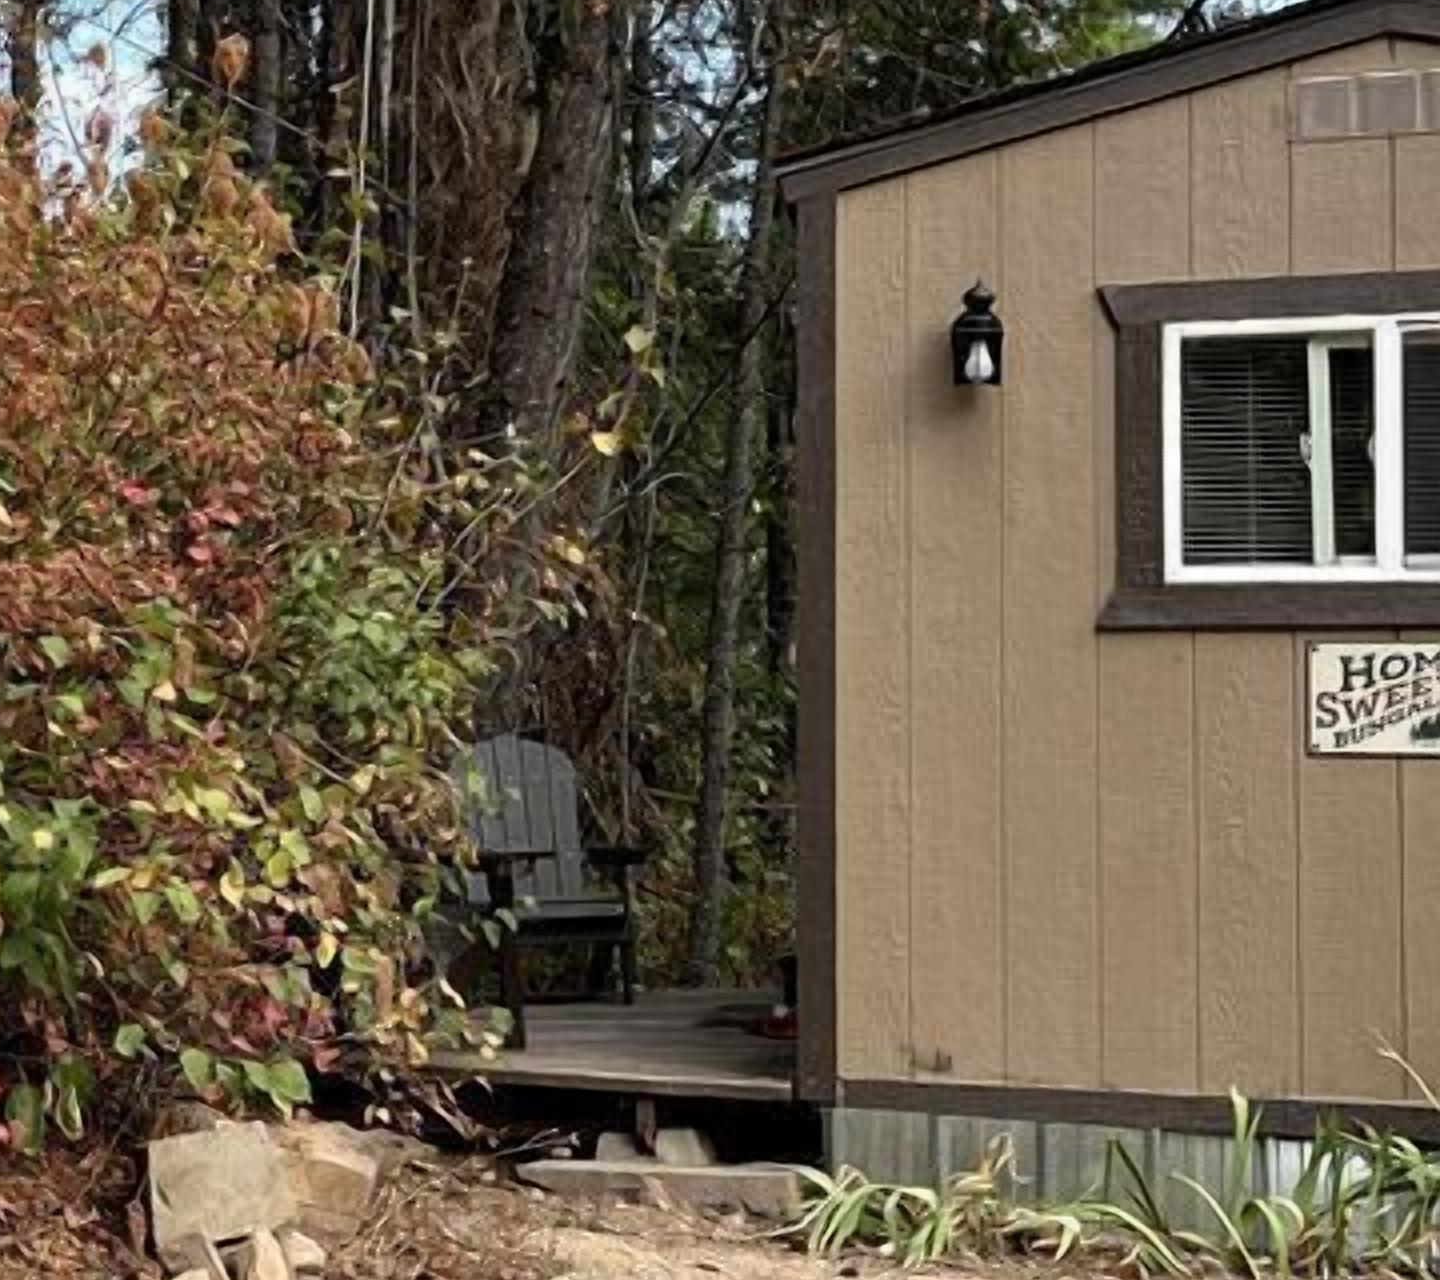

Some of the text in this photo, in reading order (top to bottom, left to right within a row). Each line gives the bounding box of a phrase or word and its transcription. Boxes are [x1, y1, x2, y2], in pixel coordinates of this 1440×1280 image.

[1339, 651, 1440, 692] HOM
[1316, 676, 1440, 729] SWEE
[1333, 697, 1440, 748] BUNGAL
